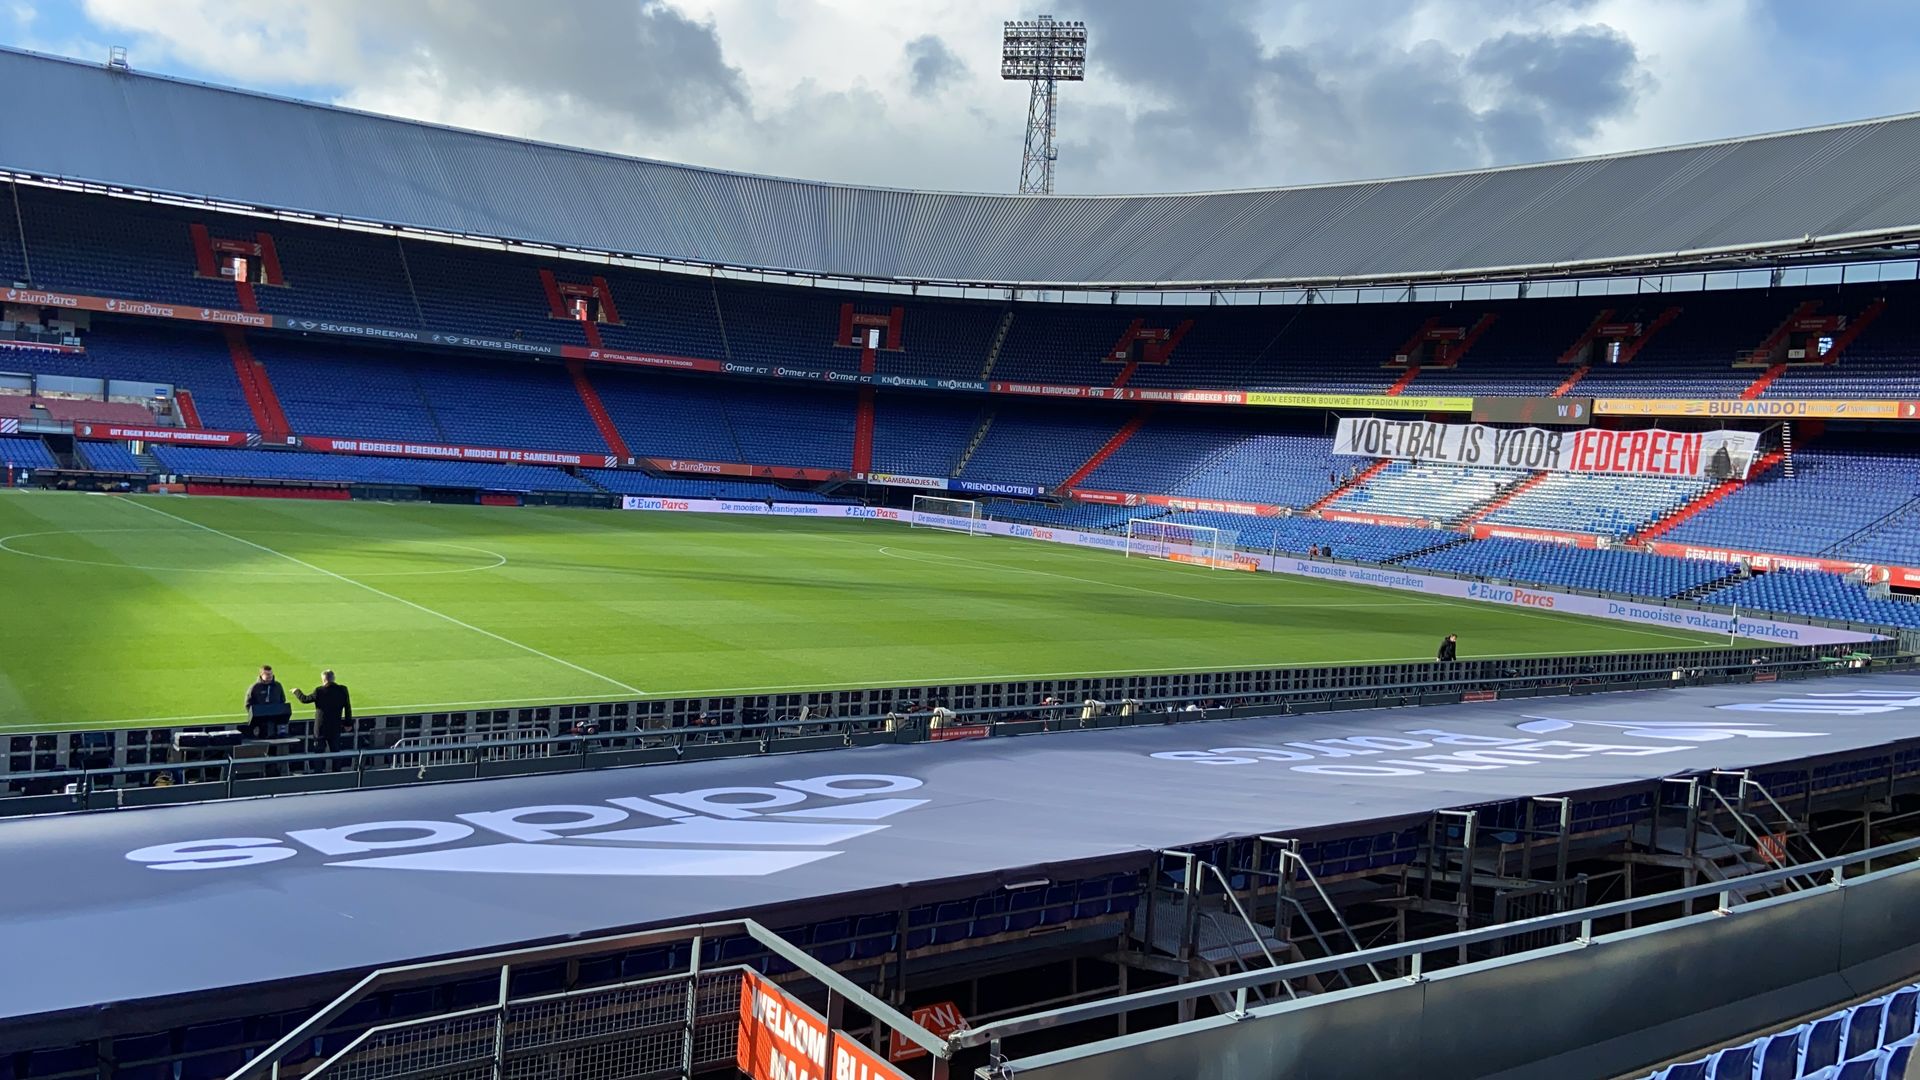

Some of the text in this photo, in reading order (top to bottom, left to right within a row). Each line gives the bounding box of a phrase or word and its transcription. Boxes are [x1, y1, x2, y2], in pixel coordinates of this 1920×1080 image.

[20, 291, 78, 307] EuroParcs
[118, 301, 174, 317] EuroParcs
[212, 310, 265, 325] EuroParcs
[725, 362, 755, 373] Ormer
[777, 367, 821, 379] Ormer ICT
[829, 371, 872, 383] Ormer ICT
[1009, 384, 1041, 394] WINNAAR
[1042, 386, 1080, 396] EUROPACUP
[1088, 388, 1105, 397] 1970
[1140, 391, 1242, 404] WINNAAR WERELDBEKER 1970
[1262, 396, 1278, 404] VAN
[1279, 397, 1317, 405] EESTEREN
[1318, 398, 1352, 406] BOUWDE
[1352, 399, 1365, 407] DIT
[1366, 399, 1399, 407] STADION
[1411, 400, 1428, 408] 1937
[1708, 402, 1795, 414] BURANDO
[110, 428, 121, 436] UIT
[144, 430, 172, 439] KRACHT
[332, 440, 581, 464] VOOR IEDEREEN BEREIKBAAR, MIDDEN IN DE SAMENLEVING
[1351, 419, 1703, 476] VOETBAL IS VOOR IEDEREEN
[679, 461, 721, 473] EuroParcs
[882, 476, 941, 487] KAMERAADJES.NL
[961, 481, 1034, 496] VRIENDENLOTERIJ
[637, 499, 689, 510] EuroParcs
[721, 502, 731, 511] De
[733, 504, 762, 512] mooiste
[852, 507, 898, 518] EuroParcs
[1015, 525, 1053, 539] EuroParcs
[1079, 534, 1089, 543] De
[1090, 536, 1115, 546] mooiste
[1296, 562, 1424, 588] De mooiste vakantieparken
[1479, 584, 1555, 608] EuroParcs
[1608, 602, 1627, 615] De
[1629, 606, 1682, 623] mooiste
[124, 773, 924, 871] adidas
[751, 985, 826, 1067] WELKOM
